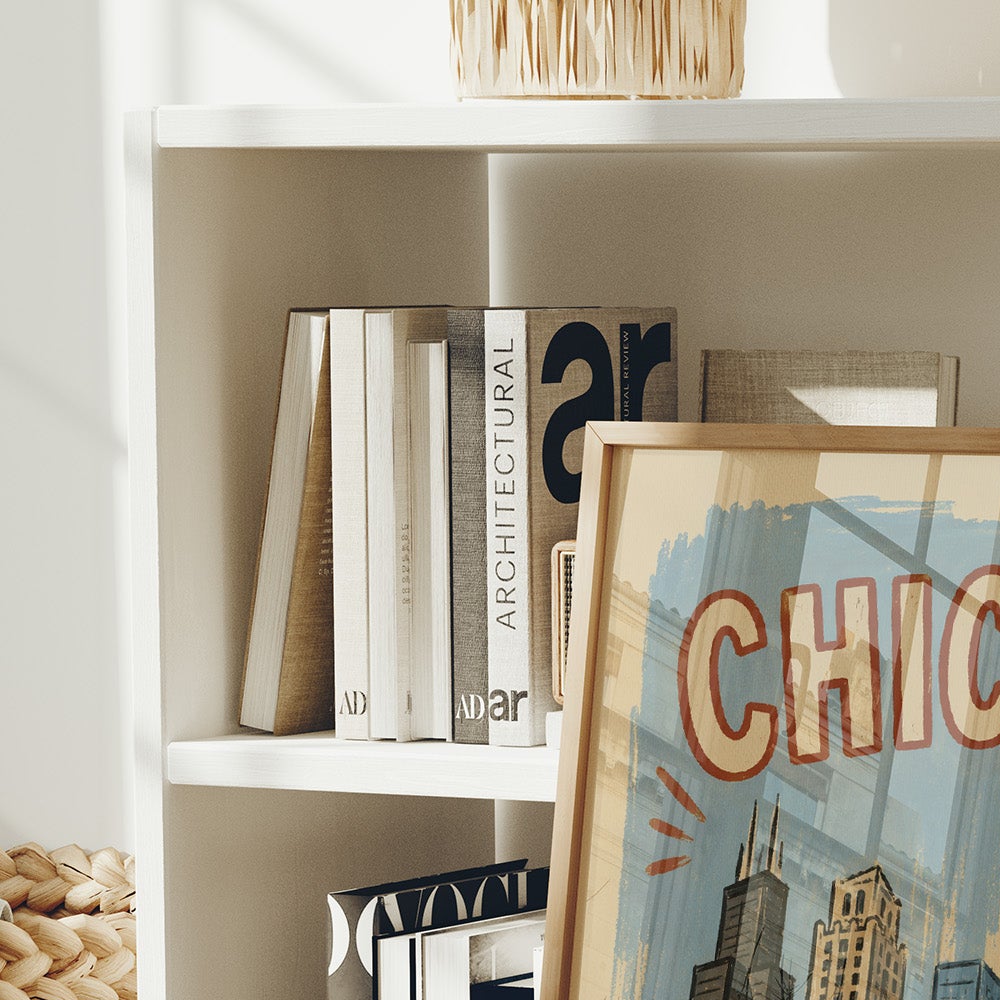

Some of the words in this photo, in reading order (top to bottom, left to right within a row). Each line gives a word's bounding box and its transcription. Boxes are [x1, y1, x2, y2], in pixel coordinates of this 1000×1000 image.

[622, 330, 630, 379] REVIEW
[541, 321, 671, 504] ar
[493, 338, 516, 630] ARCHITECTURAL
[339, 690, 367, 715] AD
[455, 694, 485, 721] AD
[489, 689, 528, 721] ar
